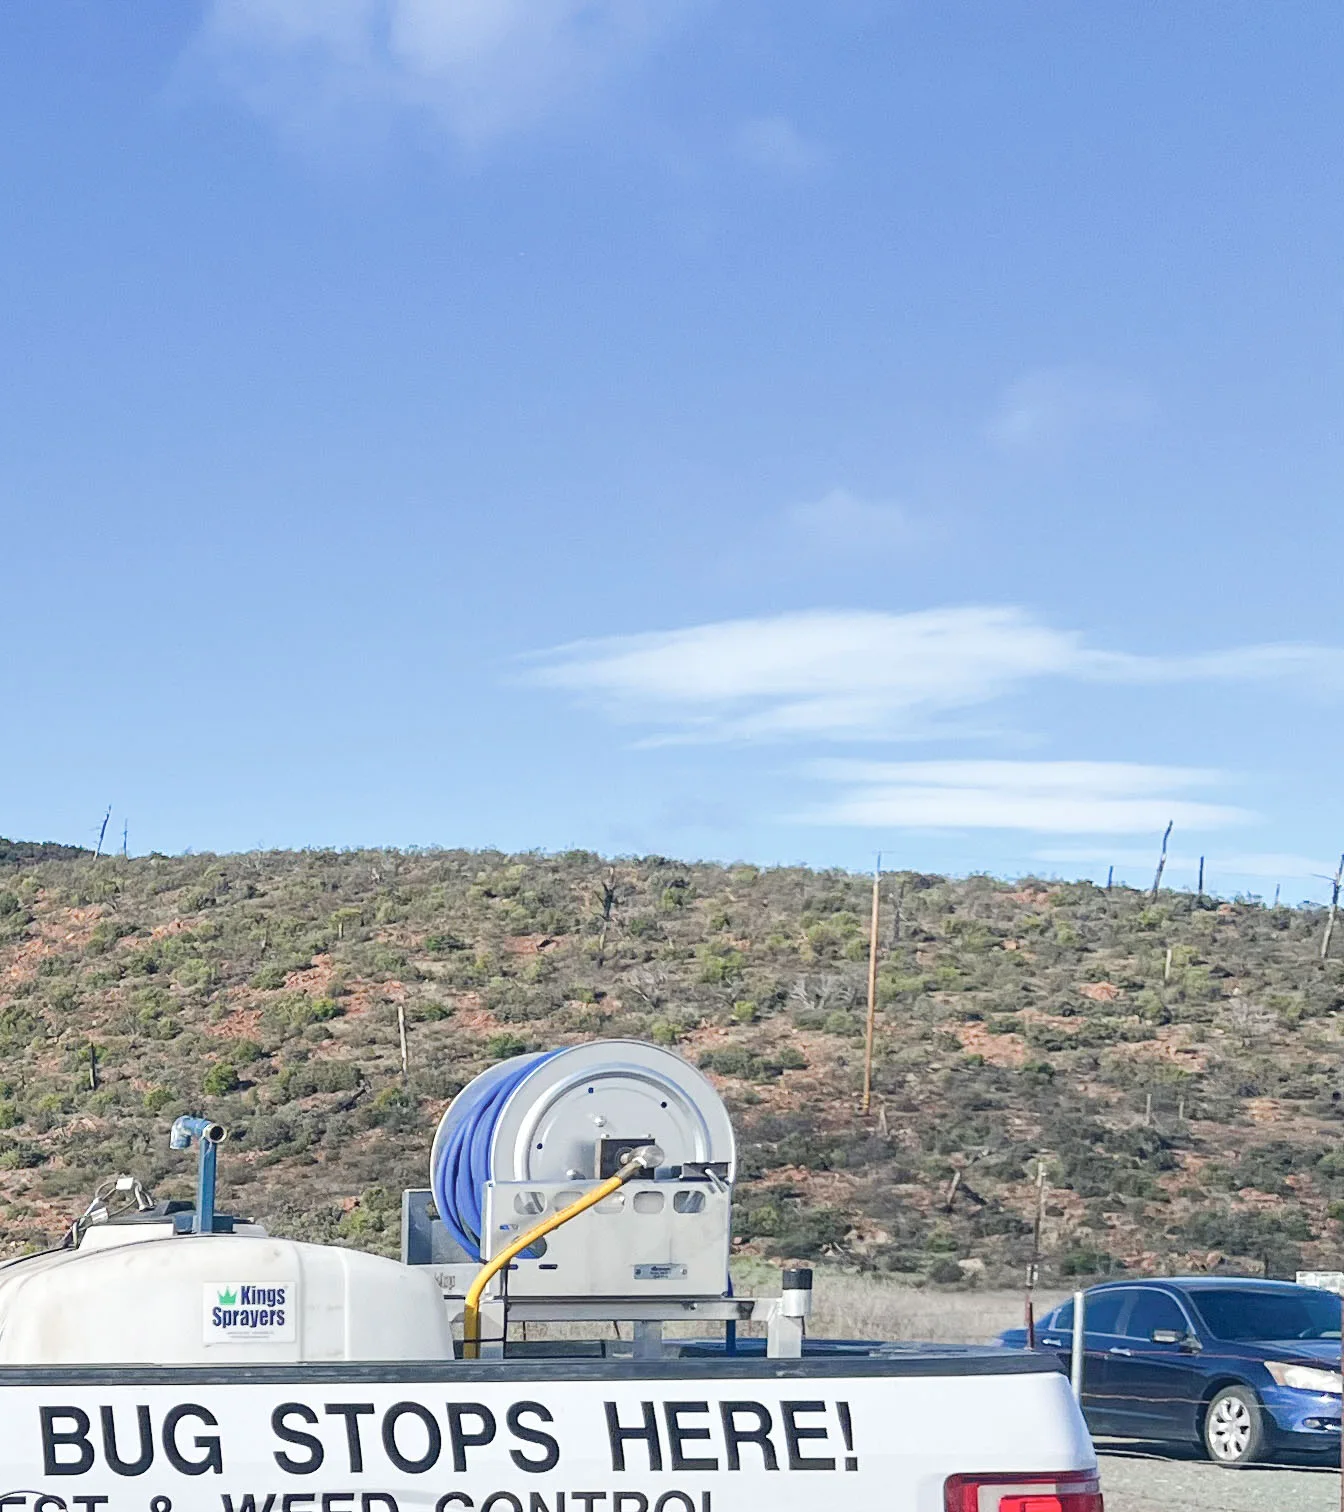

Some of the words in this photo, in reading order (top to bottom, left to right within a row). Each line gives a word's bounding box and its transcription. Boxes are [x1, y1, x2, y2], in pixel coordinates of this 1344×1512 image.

[241, 1285, 286, 1308] Kings
[212, 1306, 285, 1328] Sprayers
[40, 1404, 223, 1477] BUG
[271, 1401, 560, 1475] STOPS
[603, 1400, 859, 1472] HERE!
